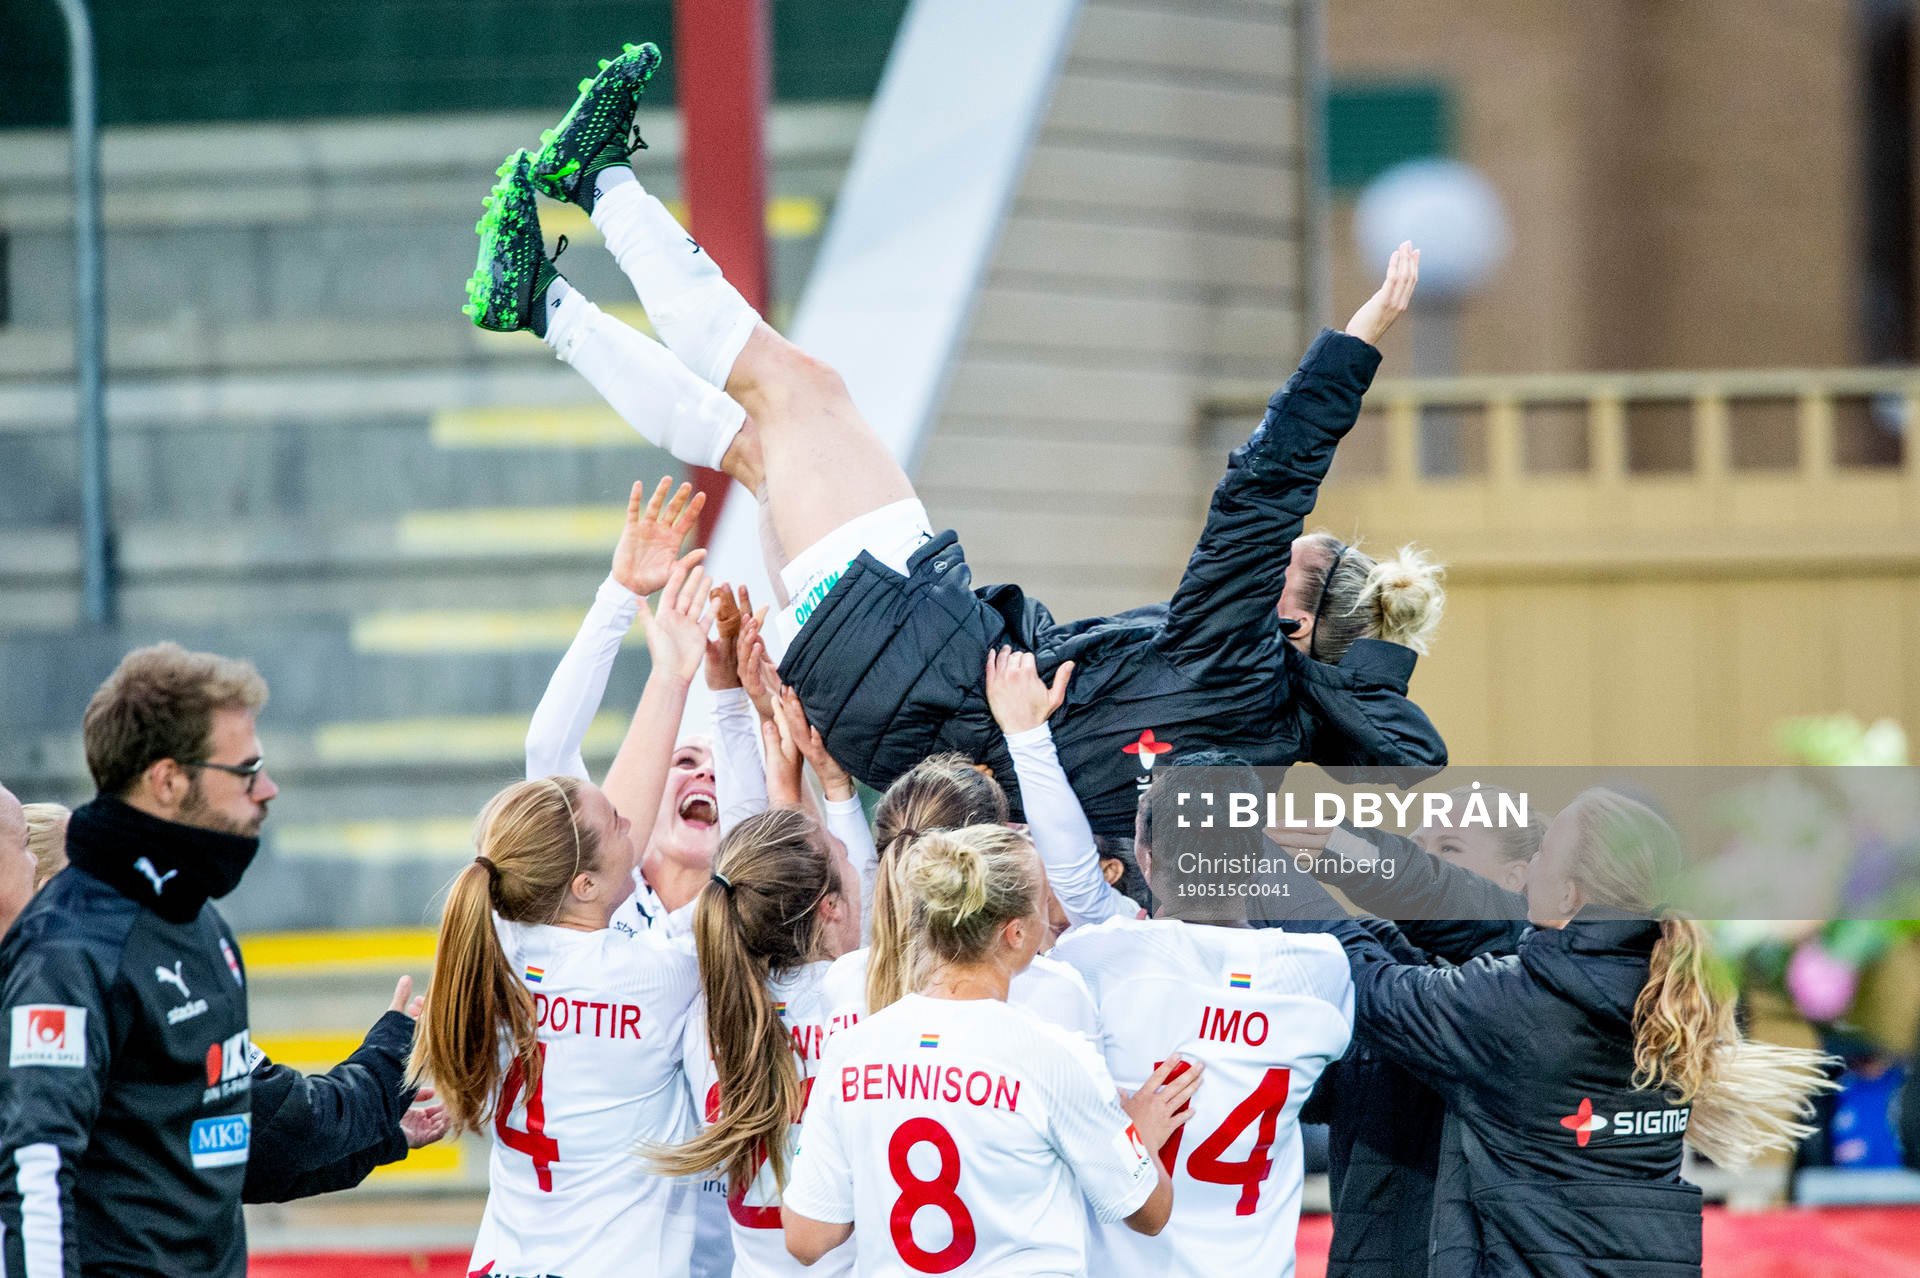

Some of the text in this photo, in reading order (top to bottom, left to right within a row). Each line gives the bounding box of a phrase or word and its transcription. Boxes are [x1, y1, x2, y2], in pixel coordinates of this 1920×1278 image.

[1199, 1006, 1269, 1047] IMO
[841, 1063, 1021, 1112] BENNISON
[197, 1121, 244, 1150] MKB
[494, 1040, 560, 1193] 4
[888, 1116, 976, 1275] 8
